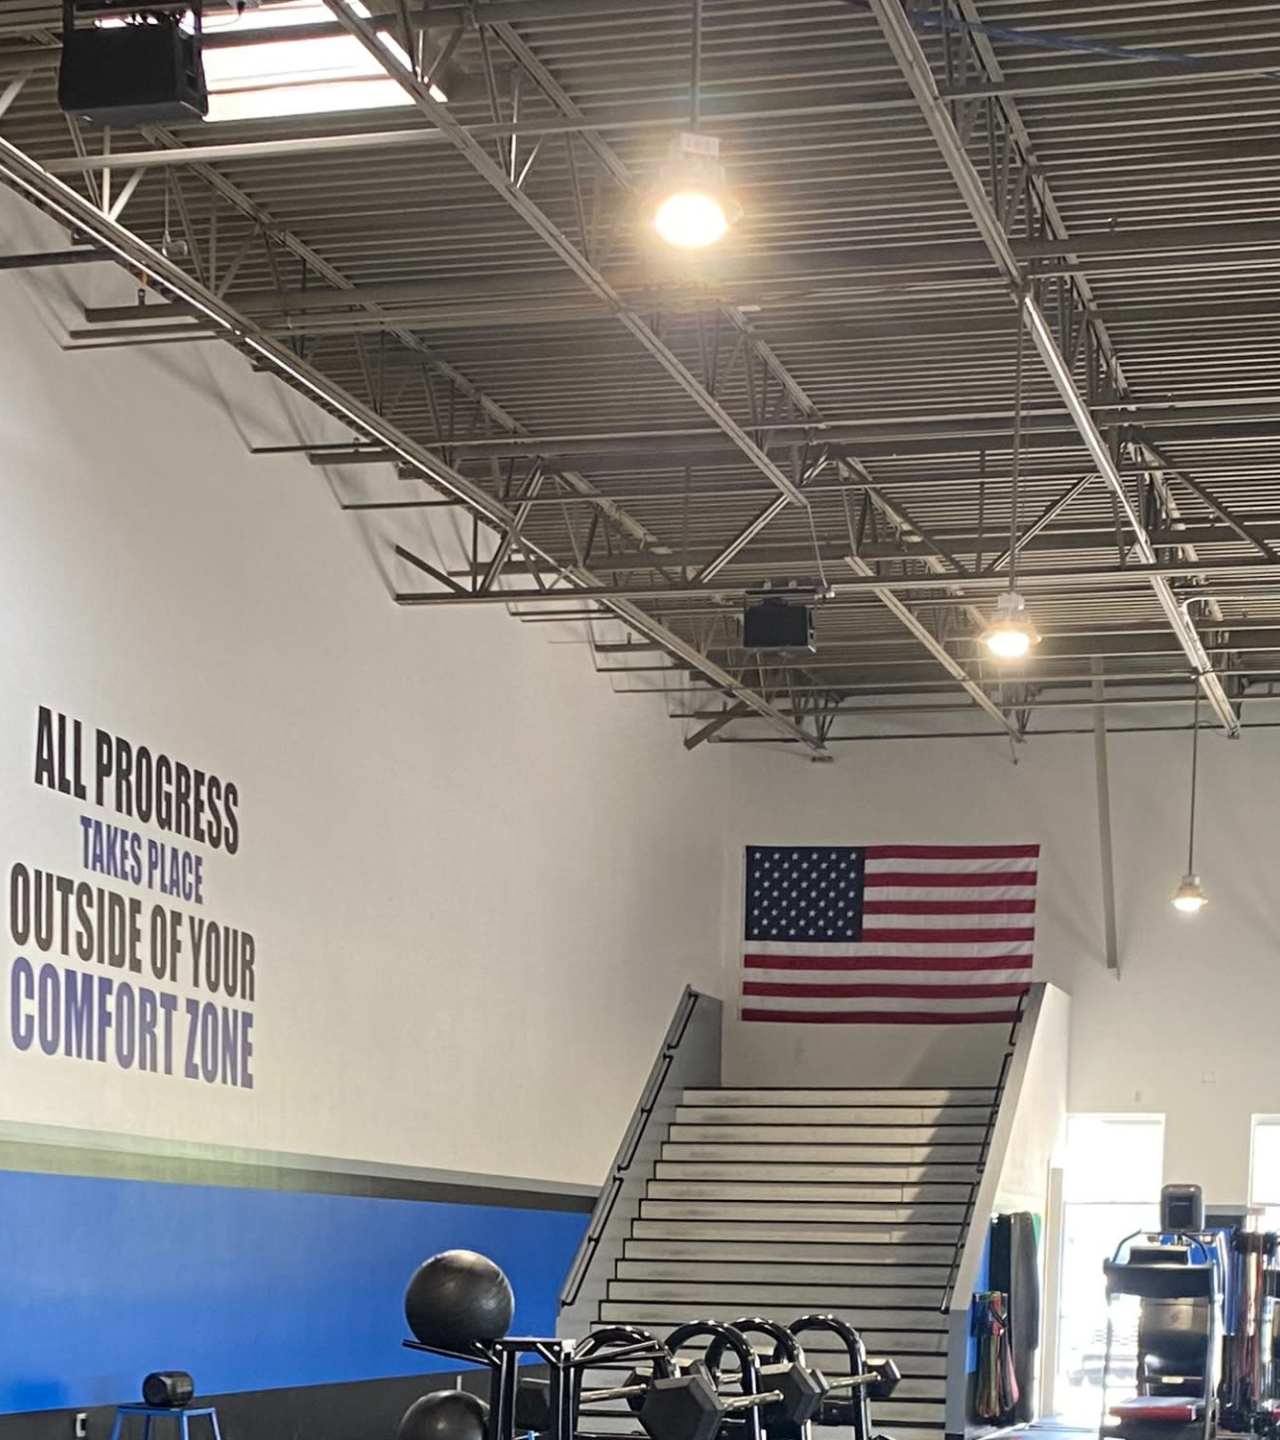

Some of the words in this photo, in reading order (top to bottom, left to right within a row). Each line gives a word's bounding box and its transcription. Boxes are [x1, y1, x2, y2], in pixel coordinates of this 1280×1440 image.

[34, 705, 86, 800] ALL
[96, 728, 239, 856] PROGRESS
[80, 815, 141, 886] TAKES
[147, 838, 202, 904] PLACE
[10, 862, 141, 974] OUTSIDE
[149, 904, 182, 983] OF
[188, 915, 255, 1001] YOUR
[11, 956, 177, 1075] COMFORT
[185, 998, 254, 1089] ZONE
